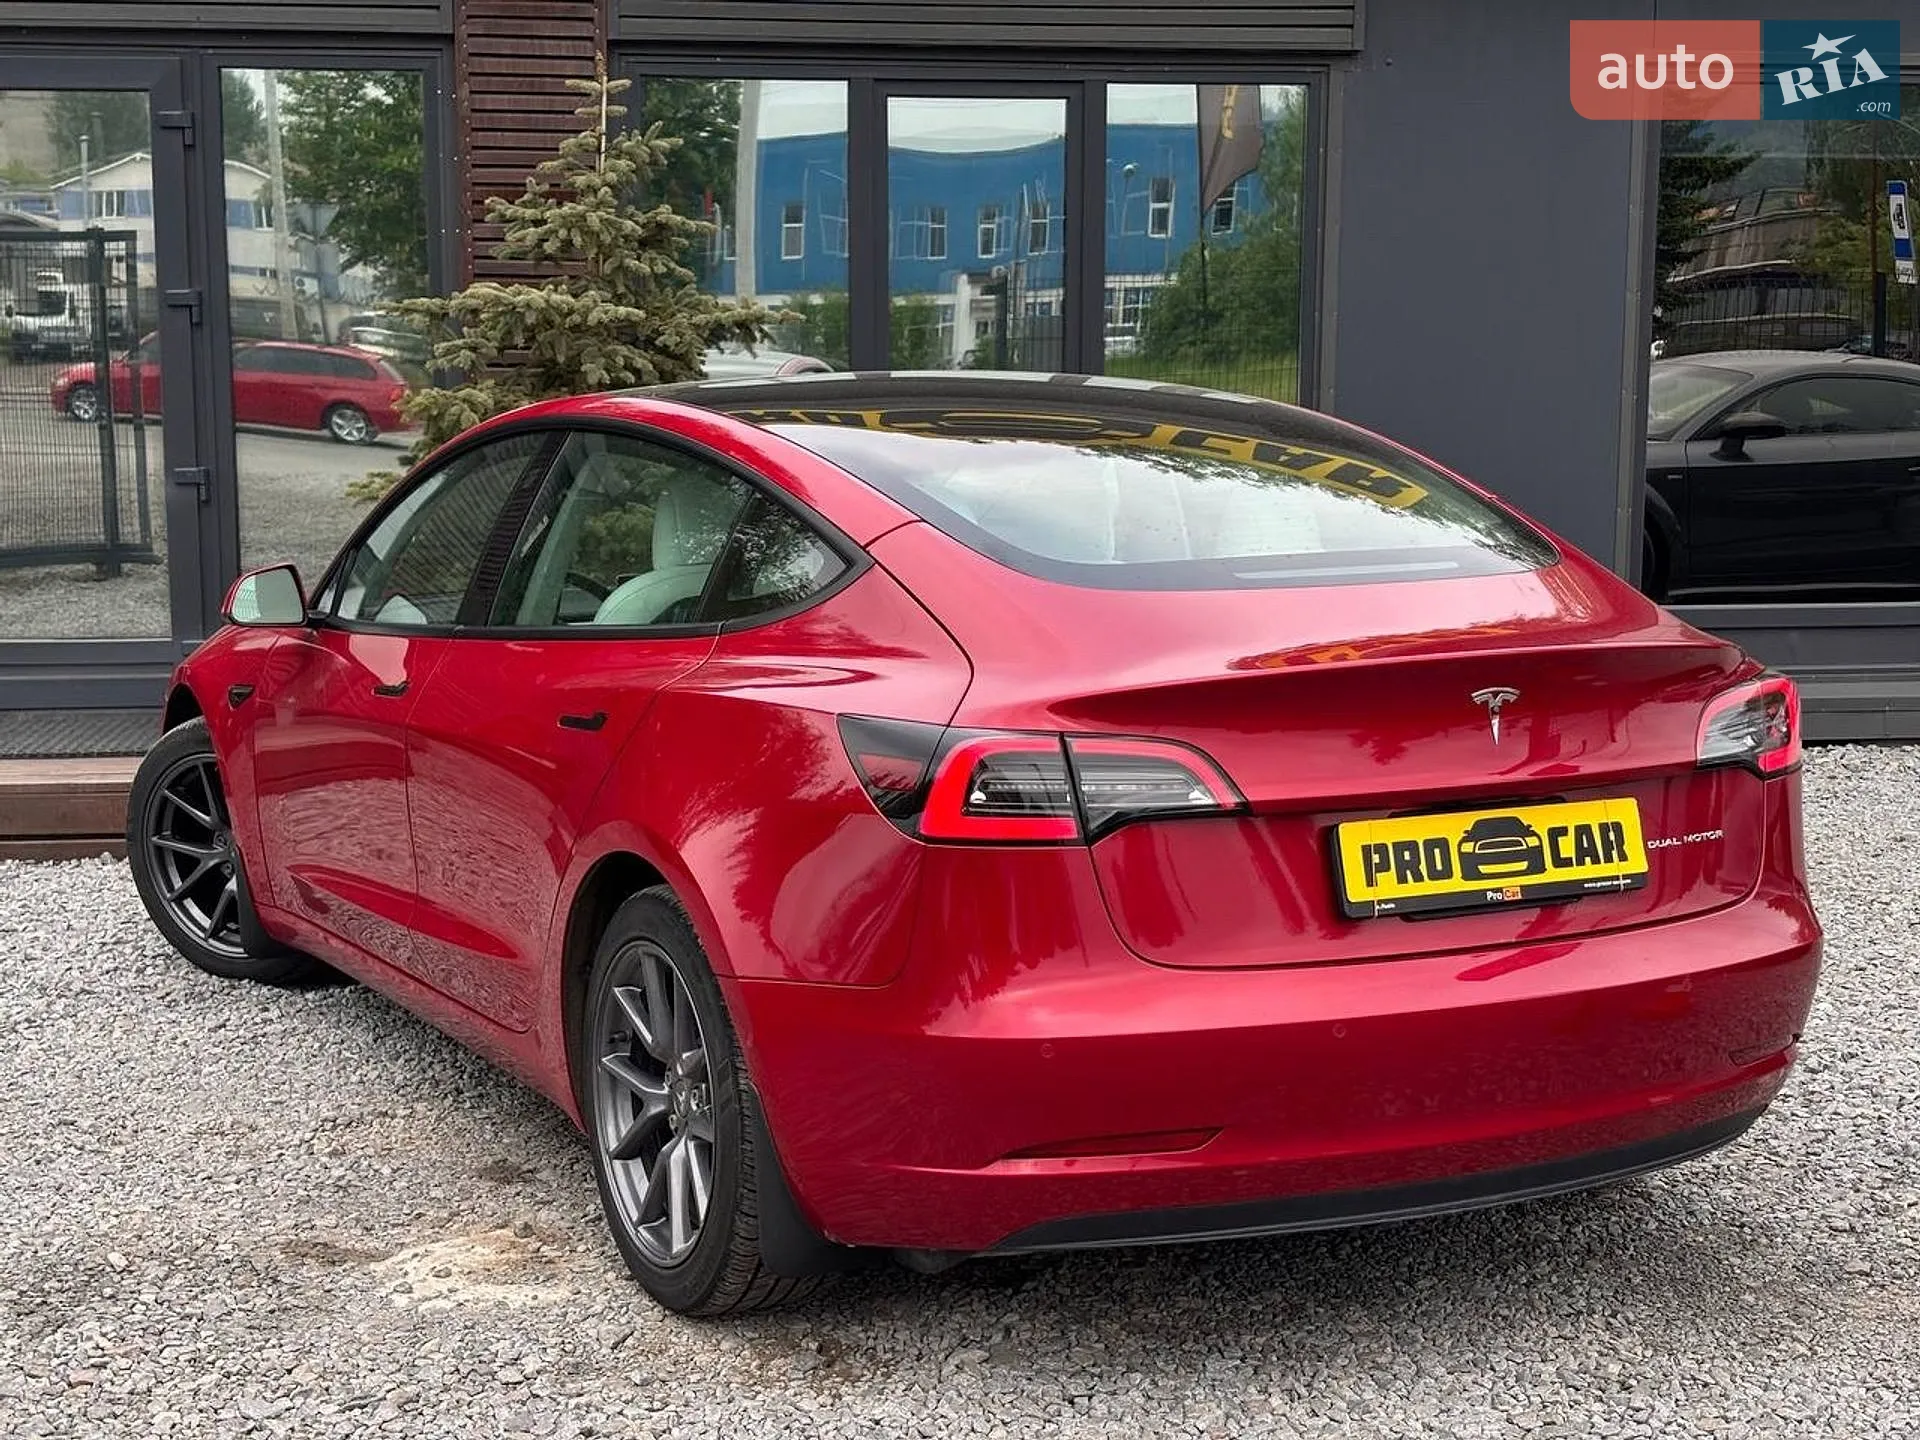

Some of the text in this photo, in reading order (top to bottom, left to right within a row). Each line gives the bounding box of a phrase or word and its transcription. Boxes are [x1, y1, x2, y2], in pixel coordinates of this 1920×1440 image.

[1361, 821, 1628, 887] PRO CAR
[1647, 830, 1723, 849] DUAL MOTOR
